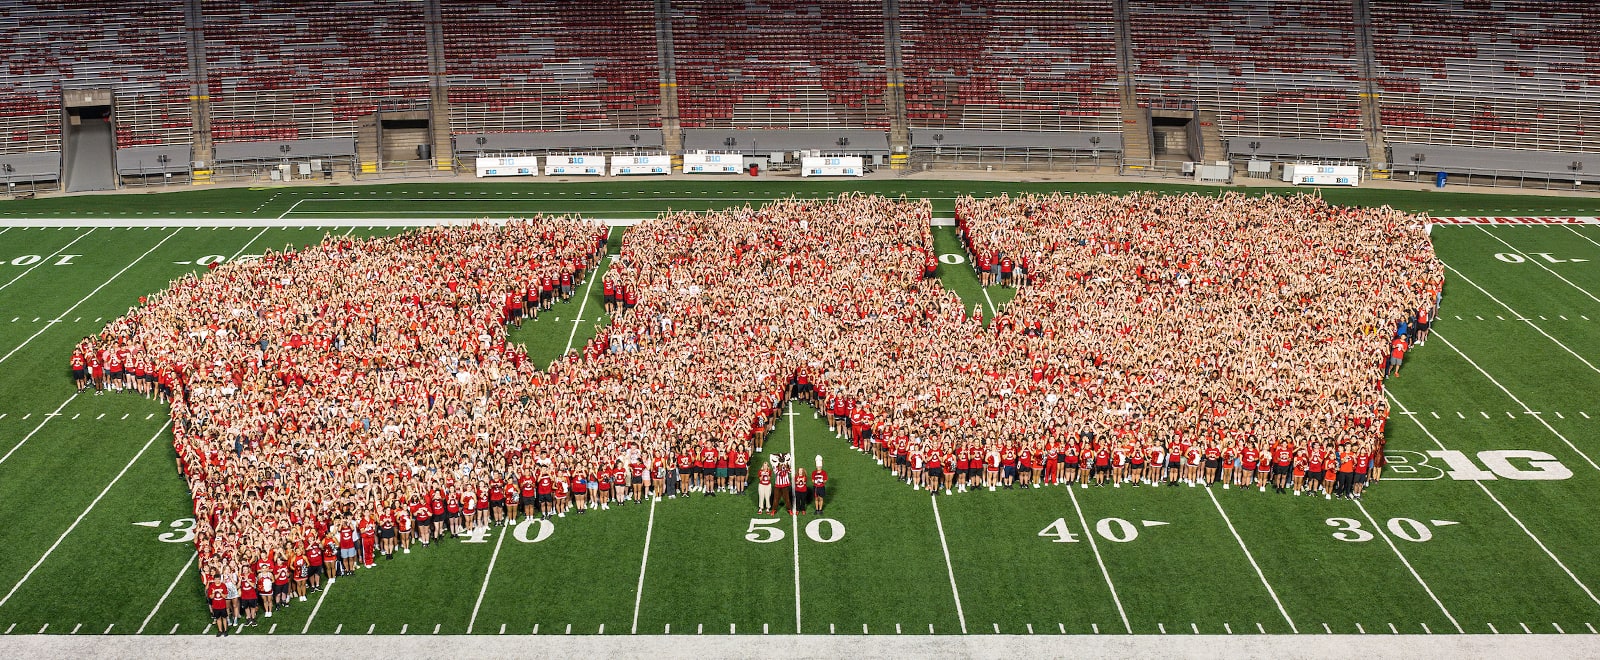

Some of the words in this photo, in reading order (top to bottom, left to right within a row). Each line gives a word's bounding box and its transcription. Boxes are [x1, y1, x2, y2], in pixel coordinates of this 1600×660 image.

[744, 518, 846, 543] 50
[1038, 517, 1139, 543] 40
[1325, 517, 1433, 542] 30
